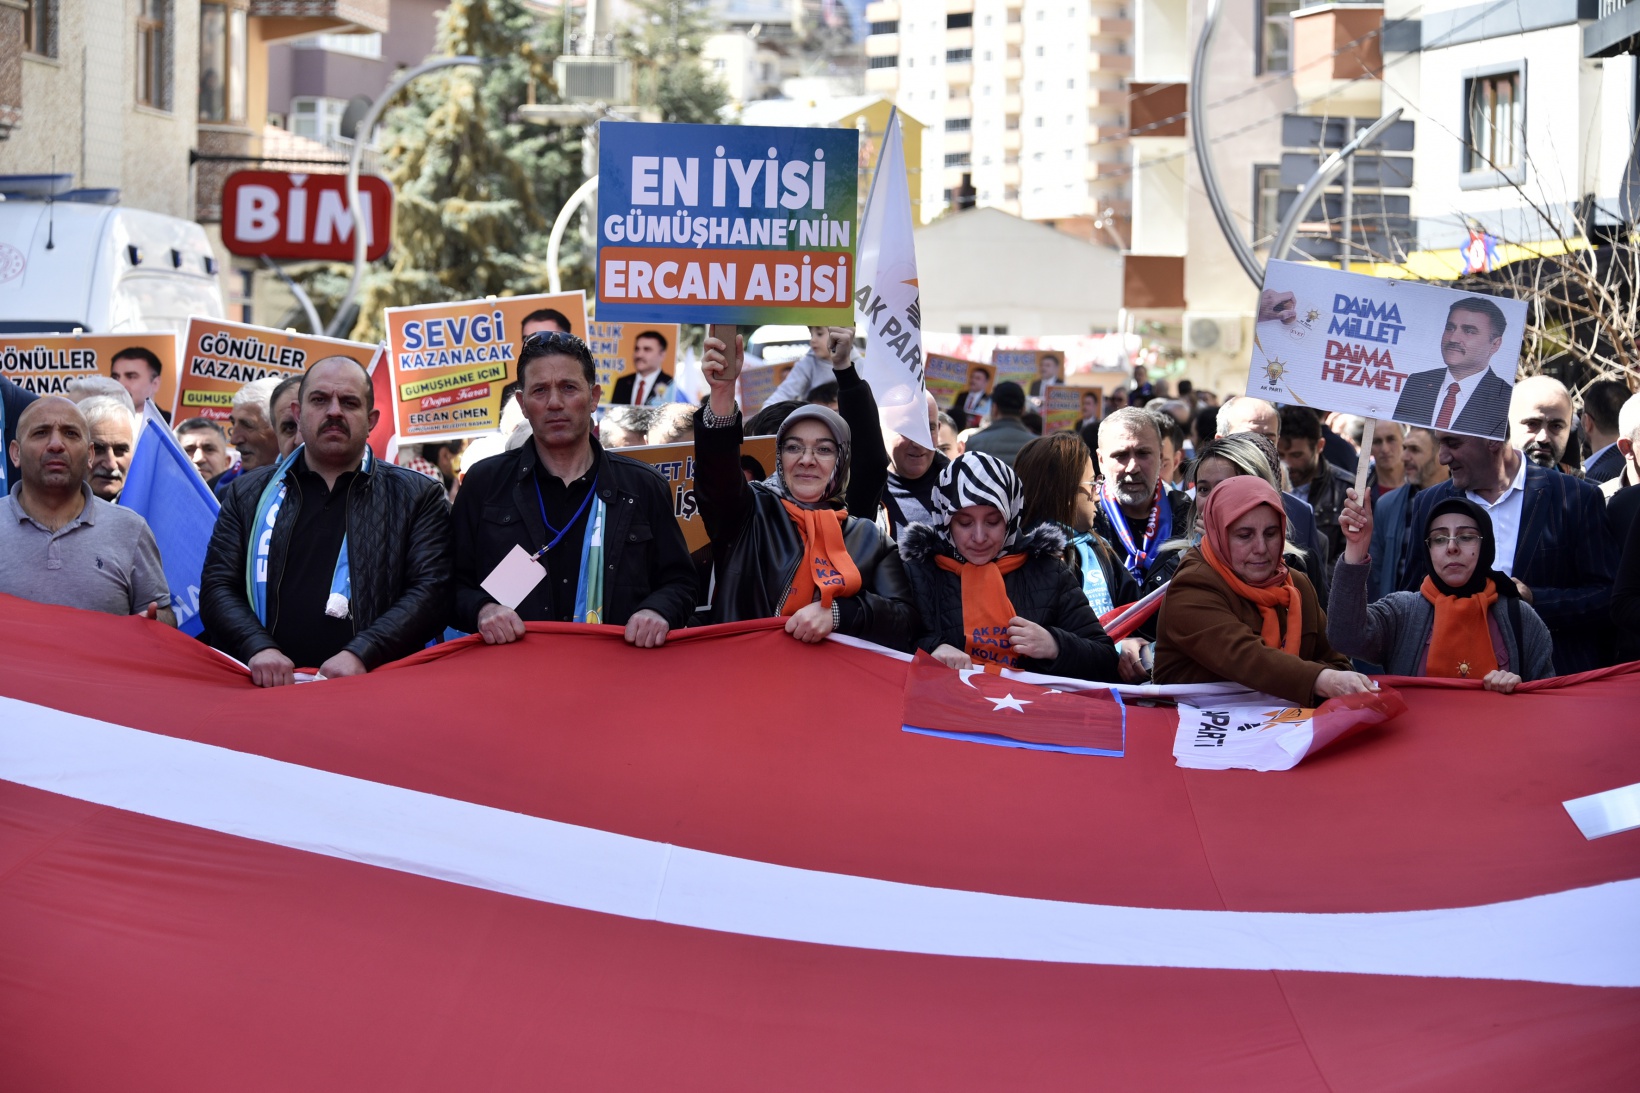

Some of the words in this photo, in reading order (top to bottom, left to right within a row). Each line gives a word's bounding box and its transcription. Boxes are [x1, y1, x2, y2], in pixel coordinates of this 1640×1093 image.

[631, 156, 699, 206] EN
[713, 145, 826, 210] İYİSİ
[235, 174, 374, 246] BİM
[604, 260, 737, 301] ERCAN
[744, 254, 847, 303] ABİSİ
[1333, 293, 1402, 324] DAİMA
[403, 311, 505, 350] SEVGİ
[589, 324, 622, 338] ALIK
[855, 285, 887, 326] AK
[879, 316, 925, 392] PAR
[1328, 314, 1406, 345] MİLLET
[200, 334, 304, 369] GÖNÜLLER
[400, 344, 514, 370] KAZANACAK
[591, 339, 618, 354] EMİ
[1325, 340, 1394, 370] DAİMA
[0, 348, 95, 370] ÖNÜLLER
[595, 358, 625, 372] ANIŞ
[595, 373, 610, 384] AK
[1321, 360, 1408, 392] HİZMET
[410, 410, 449, 424] ERCAN
[452, 407, 488, 421] ÇİMEN
[675, 486, 699, 520] İŞ
[814, 557, 828, 567] AK
[815, 568, 842, 579] KA
[1089, 597, 1110, 606] ERC
[972, 627, 989, 636] AK
[993, 627, 1008, 635] PA
[972, 635, 1011, 649] KAD
[971, 647, 1018, 667] KOLLAR
